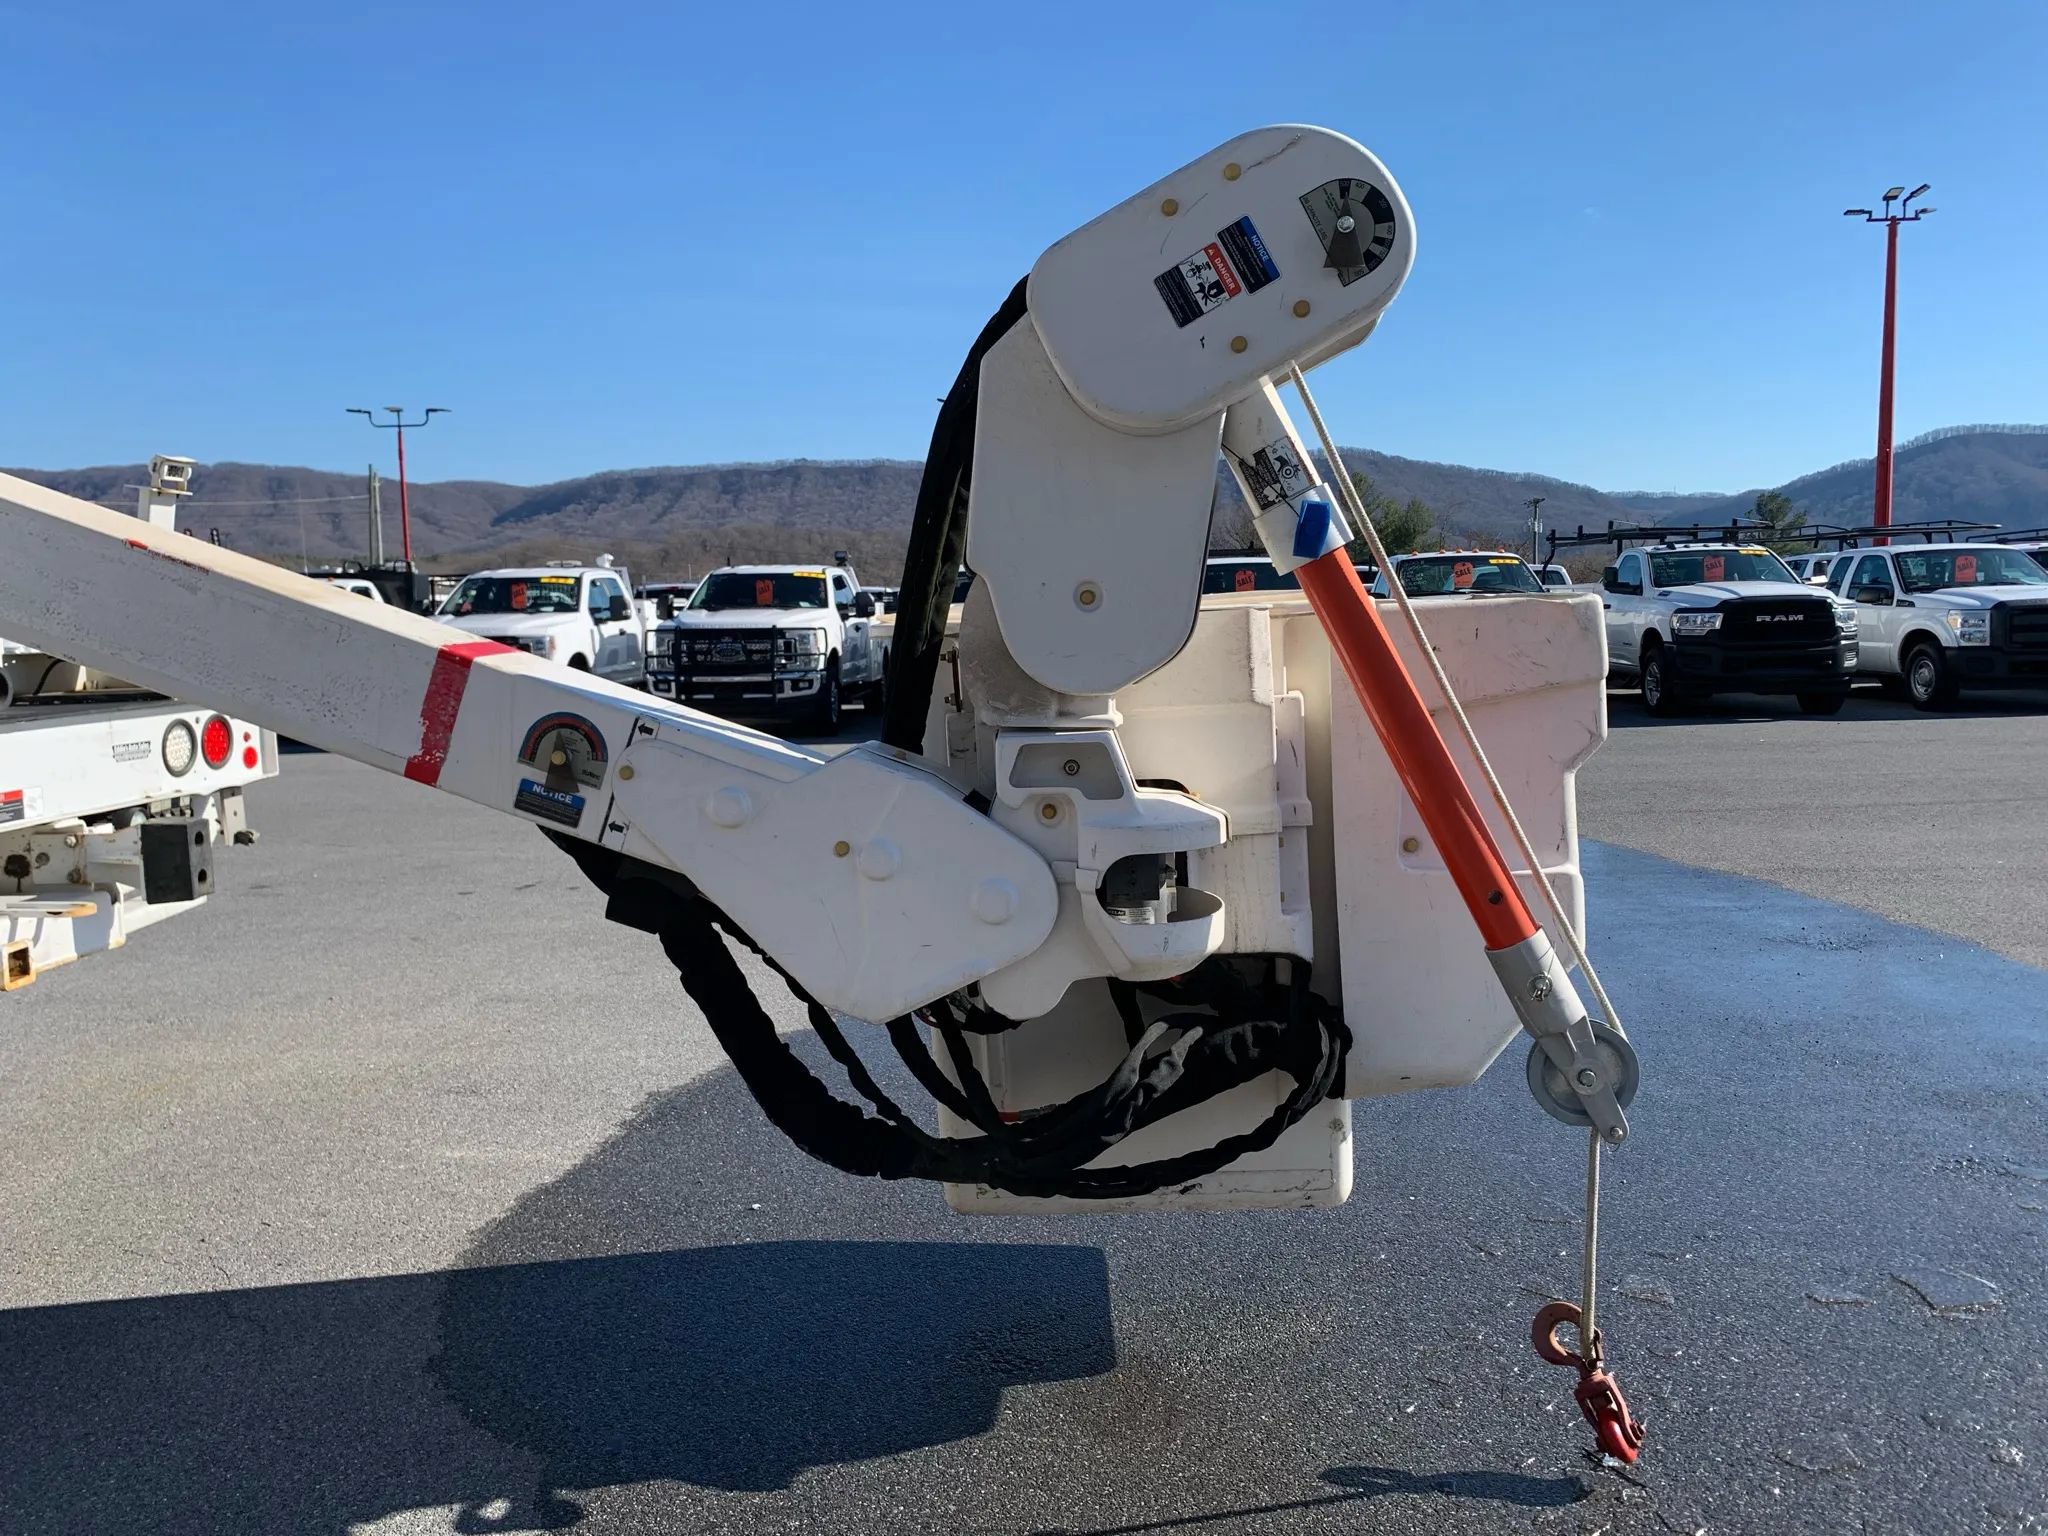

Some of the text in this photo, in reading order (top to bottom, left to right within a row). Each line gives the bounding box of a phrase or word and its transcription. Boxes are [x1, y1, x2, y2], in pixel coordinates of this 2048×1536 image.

[1251, 235, 1270, 261] NOTICE
[1214, 257, 1236, 290] DANGER
[1705, 560, 1723, 571] SALE
[1455, 567, 1472, 578] SALE
[1237, 575, 1253, 587] SALE
[1756, 614, 1804, 622] RAM
